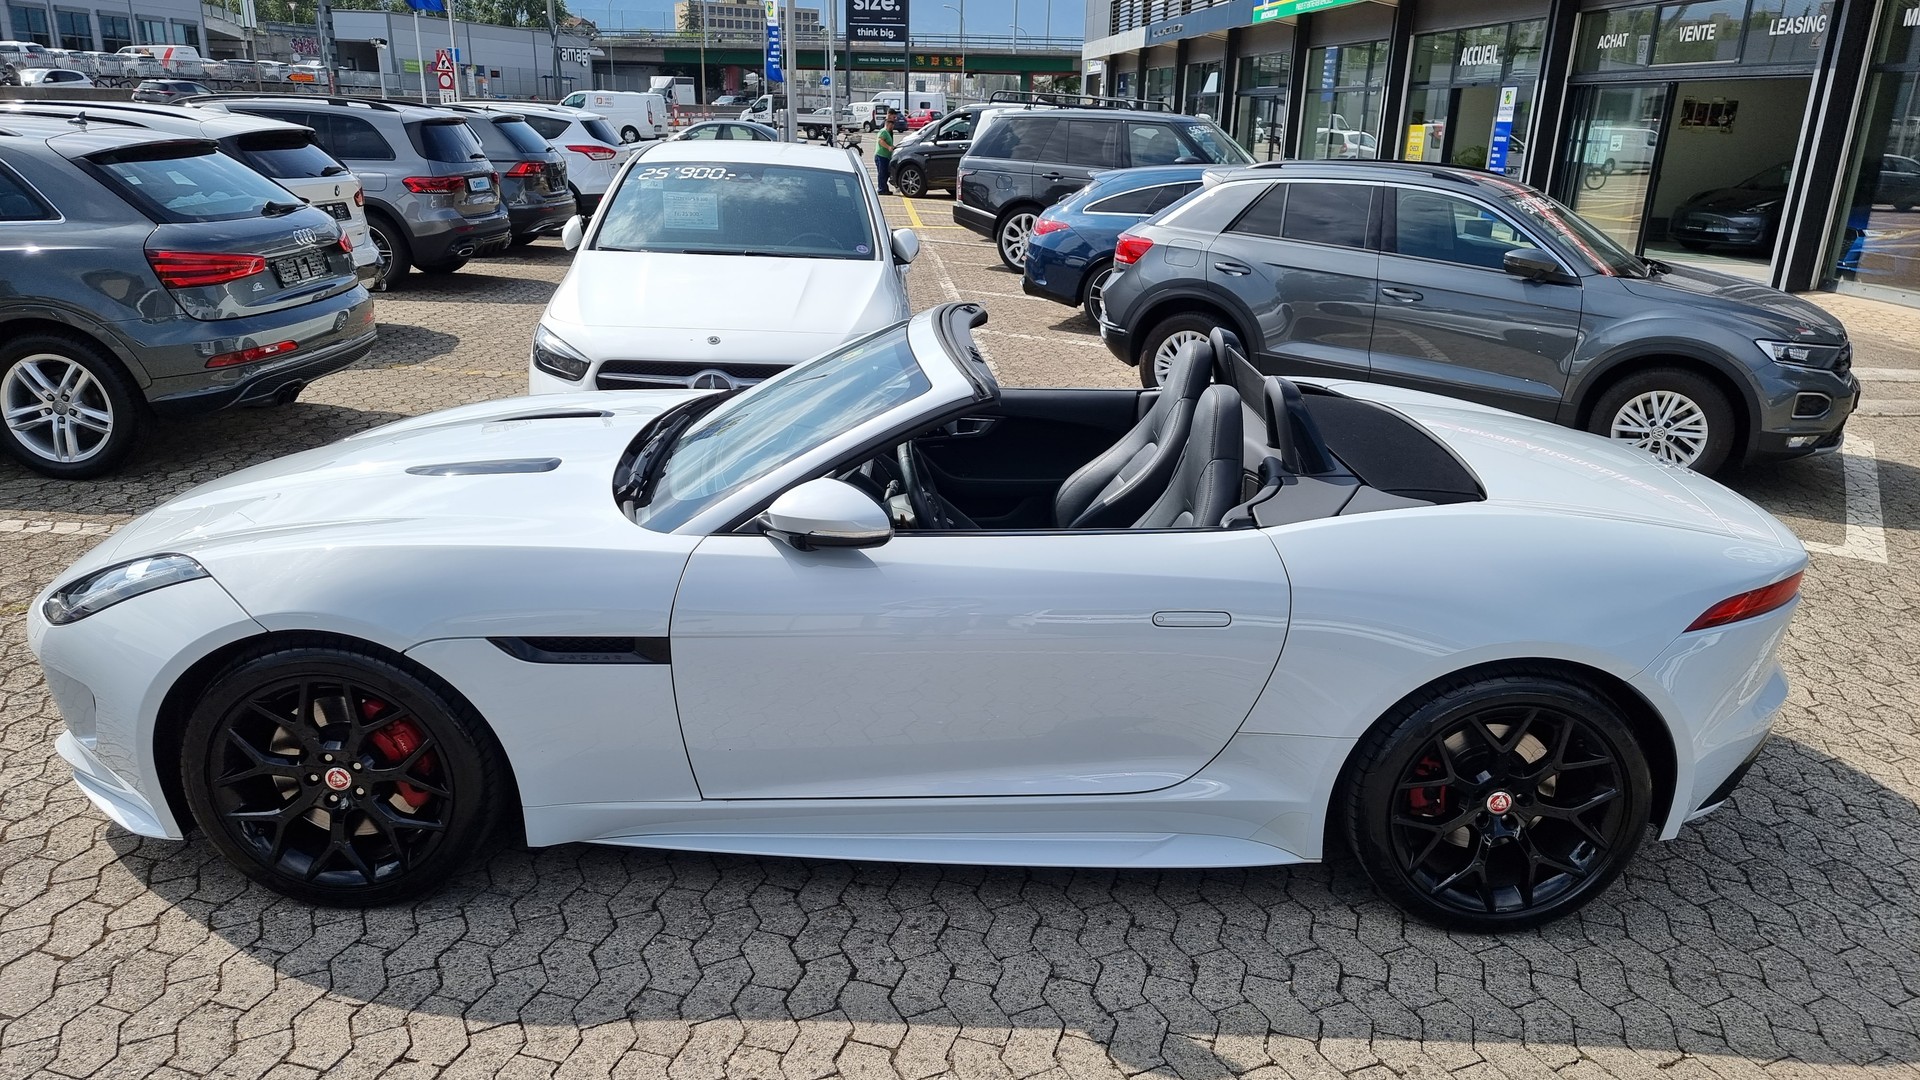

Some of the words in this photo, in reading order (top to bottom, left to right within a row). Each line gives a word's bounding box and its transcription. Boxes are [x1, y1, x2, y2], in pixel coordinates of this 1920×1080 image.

[857, 28, 879, 37] think
[880, 28, 897, 39] big.
[1679, 23, 1717, 43] VENTE
[1768, 15, 1828, 36] LEASING
[1597, 33, 1630, 49] ACHAT
[561, 48, 590, 67] amag
[1460, 44, 1498, 66] ACCUEIL
